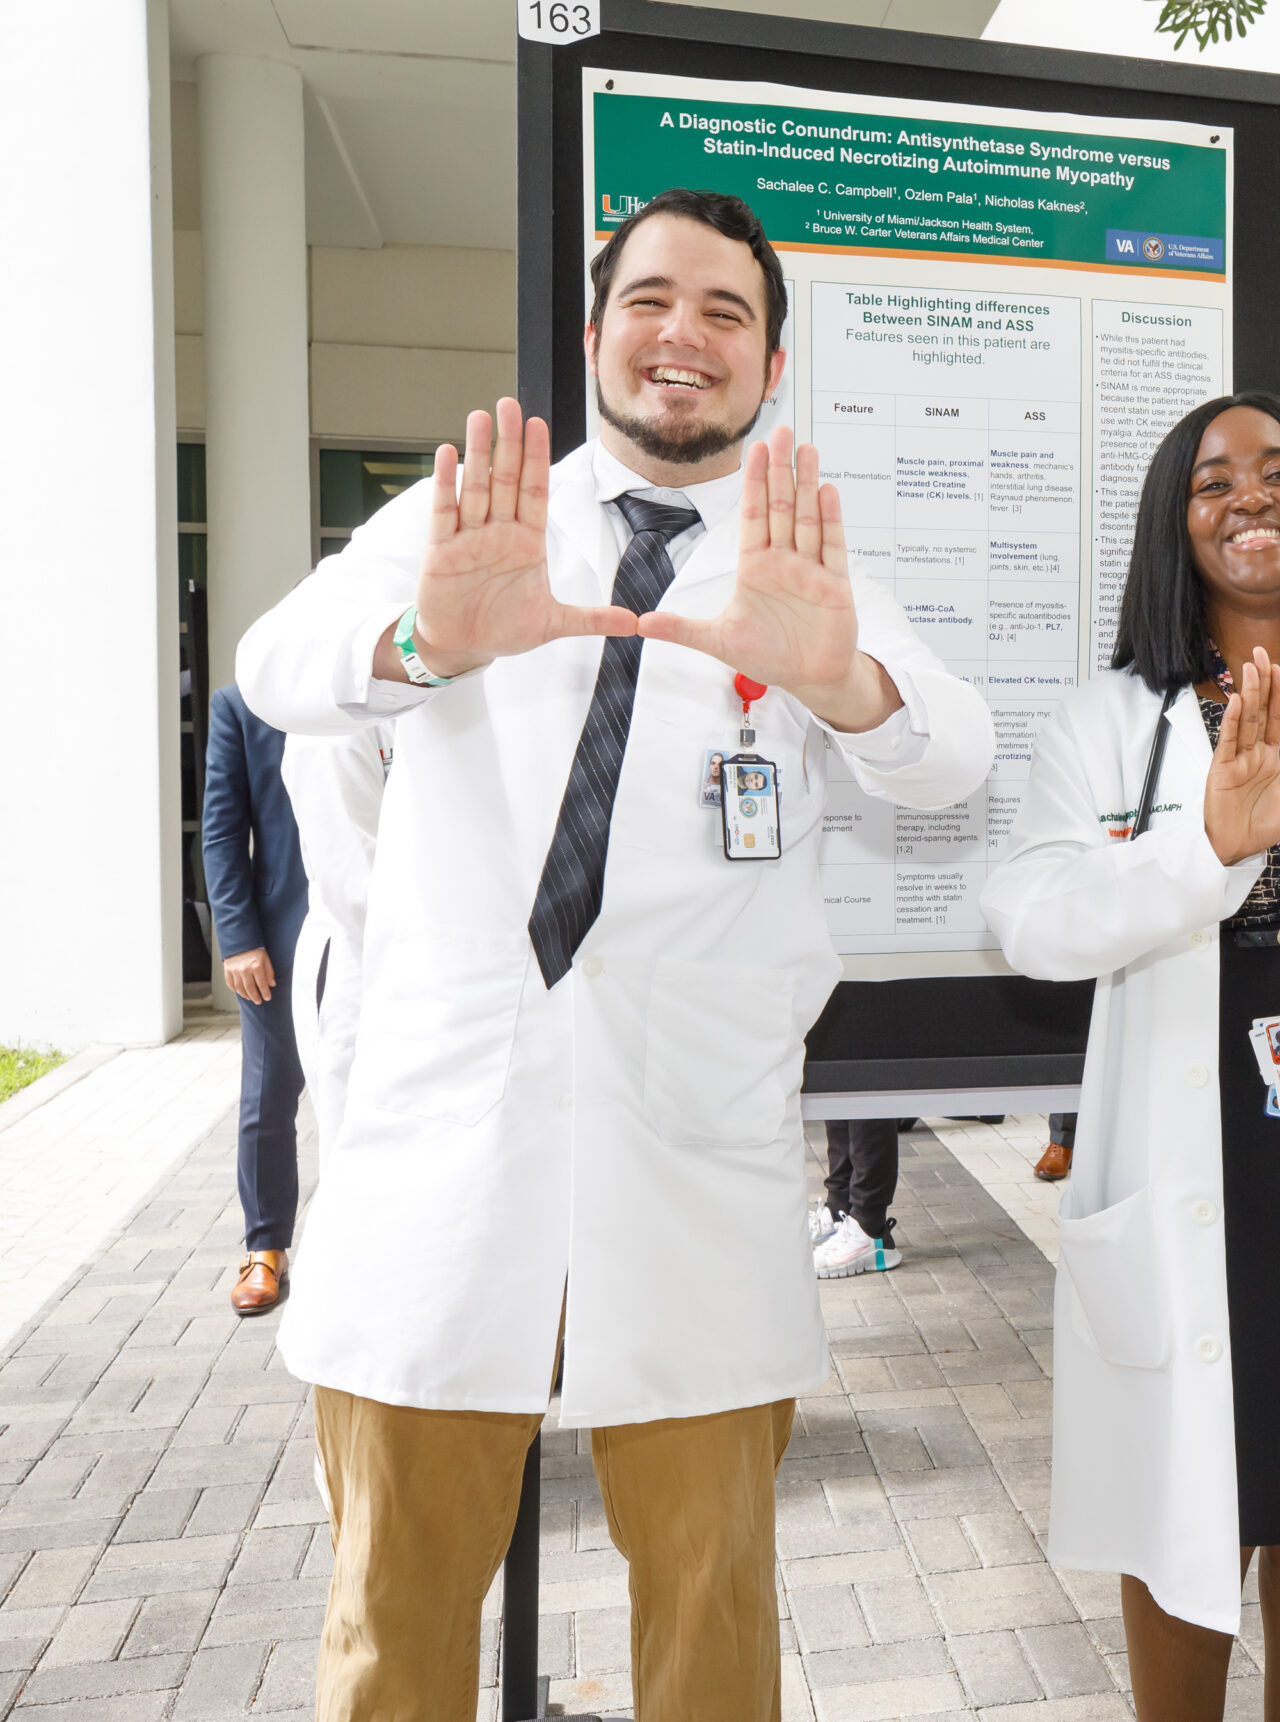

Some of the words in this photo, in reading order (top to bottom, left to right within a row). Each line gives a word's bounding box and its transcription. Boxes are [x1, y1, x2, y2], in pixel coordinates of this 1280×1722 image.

[530, 1, 591, 35] 163
[660, 112, 674, 128] A
[680, 113, 776, 134] Diagnostic
[782, 121, 892, 145] Conundrum:
[897, 130, 1025, 155] Antisynthetase
[1030, 141, 1113, 164] Syndrome
[1119, 152, 1170, 170] versus
[704, 138, 834, 162] Statin-Induced
[840, 148, 938, 173] Necrotizing
[943, 156, 1050, 180] Autoimmune
[1056, 166, 1134, 190] Myopathy
[757, 178, 814, 193] Sachalee
[818, 182, 831, 194] C.
[905, 188, 943, 202] Ozlem
[985, 194, 1035, 209] Nicholas
[824, 210, 873, 224] University
[875, 214, 885, 223] of
[888, 214, 959, 228] Miami/Jackson
[962, 220, 993, 231] Health
[996, 222, 1033, 235] System,
[813, 223, 842, 234] Bruce
[845, 225, 857, 235] W.
[861, 226, 892, 237] Carter
[894, 228, 938, 240] Veterans
[939, 232, 970, 243] Affairs
[973, 234, 1009, 245] Medical
[1012, 236, 1044, 248] Center
[1116, 239, 1134, 253] VA
[846, 292, 883, 306] Table
[888, 295, 971, 313] Highlighting
[976, 300, 1050, 315] differences
[863, 312, 922, 326] Between
[927, 315, 972, 328] SINAM
[977, 319, 1001, 330] and
[1006, 320, 1034, 331] ASS
[1122, 312, 1192, 327] Discussion
[846, 328, 903, 343] Features
[908, 335, 938, 344] seen
[943, 337, 954, 345] in
[958, 334, 980, 346] this
[984, 337, 1026, 349] patient
[1030, 341, 1050, 350] are
[1101, 333, 1123, 342] While
[1171, 338, 1185, 346] had
[913, 350, 985, 366] highlighted.
[835, 403, 874, 413] Feature
[925, 408, 959, 417] SINAM
[1024, 412, 1046, 421] ASS
[897, 457, 925, 465] Muscle
[927, 491, 944, 500] (CK)
[974, 493, 983, 501] [1]
[990, 541, 1037, 550] Multisystem
[1065, 677, 1074, 686] [3]
[704, 792, 715, 802] VA
[989, 796, 1021, 804] Requires
[928, 824, 961, 832] including
[897, 874, 936, 882] Symptoms
